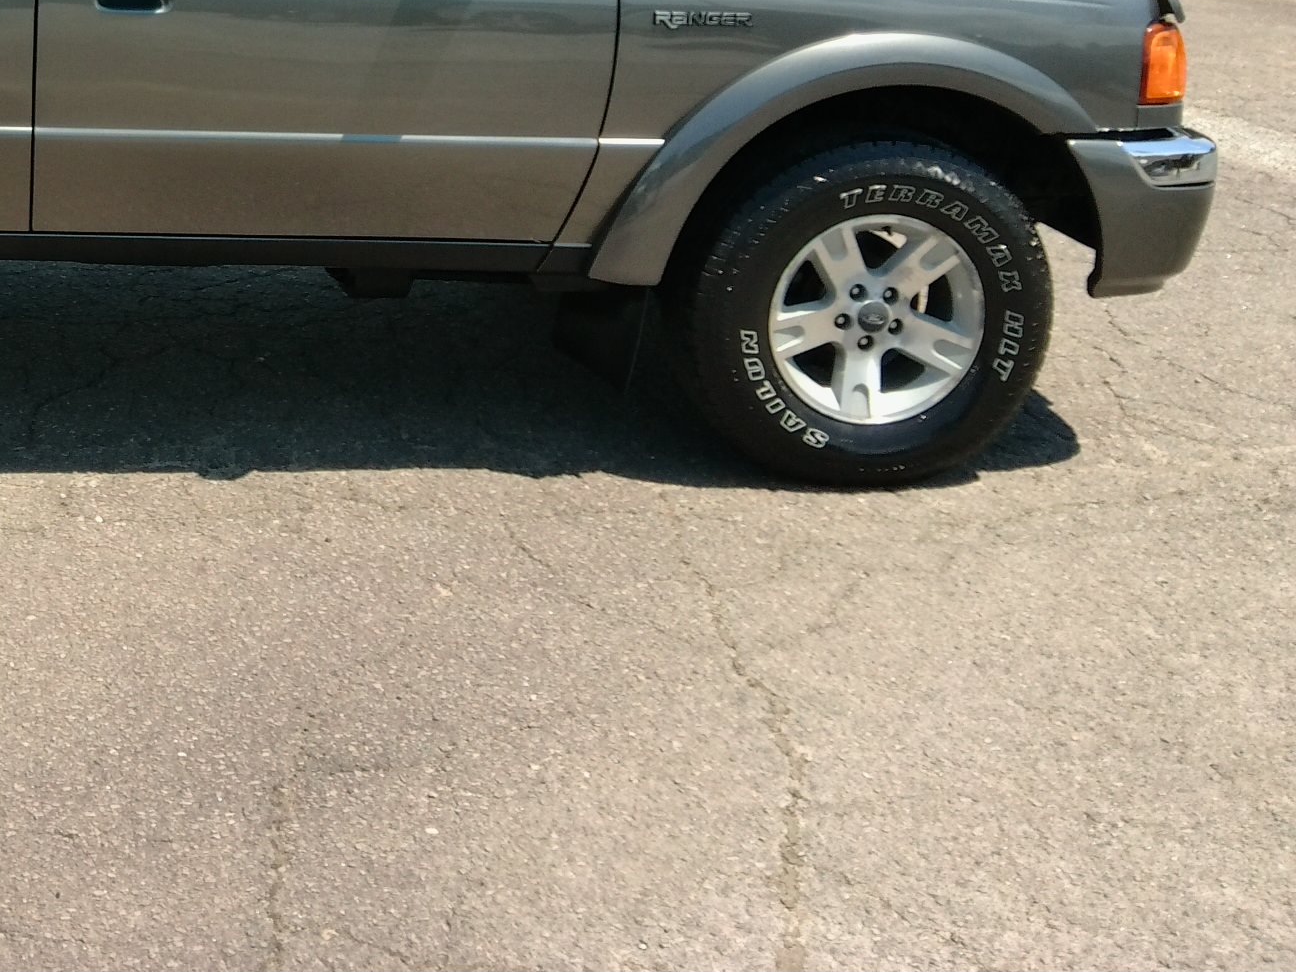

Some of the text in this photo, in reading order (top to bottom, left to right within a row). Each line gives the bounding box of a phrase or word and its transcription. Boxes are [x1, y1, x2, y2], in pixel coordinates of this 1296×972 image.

[654, 9, 753, 30] RANGER
[839, 184, 1025, 382] TERRAMAX HLT
[740, 329, 830, 449] SAILUN
